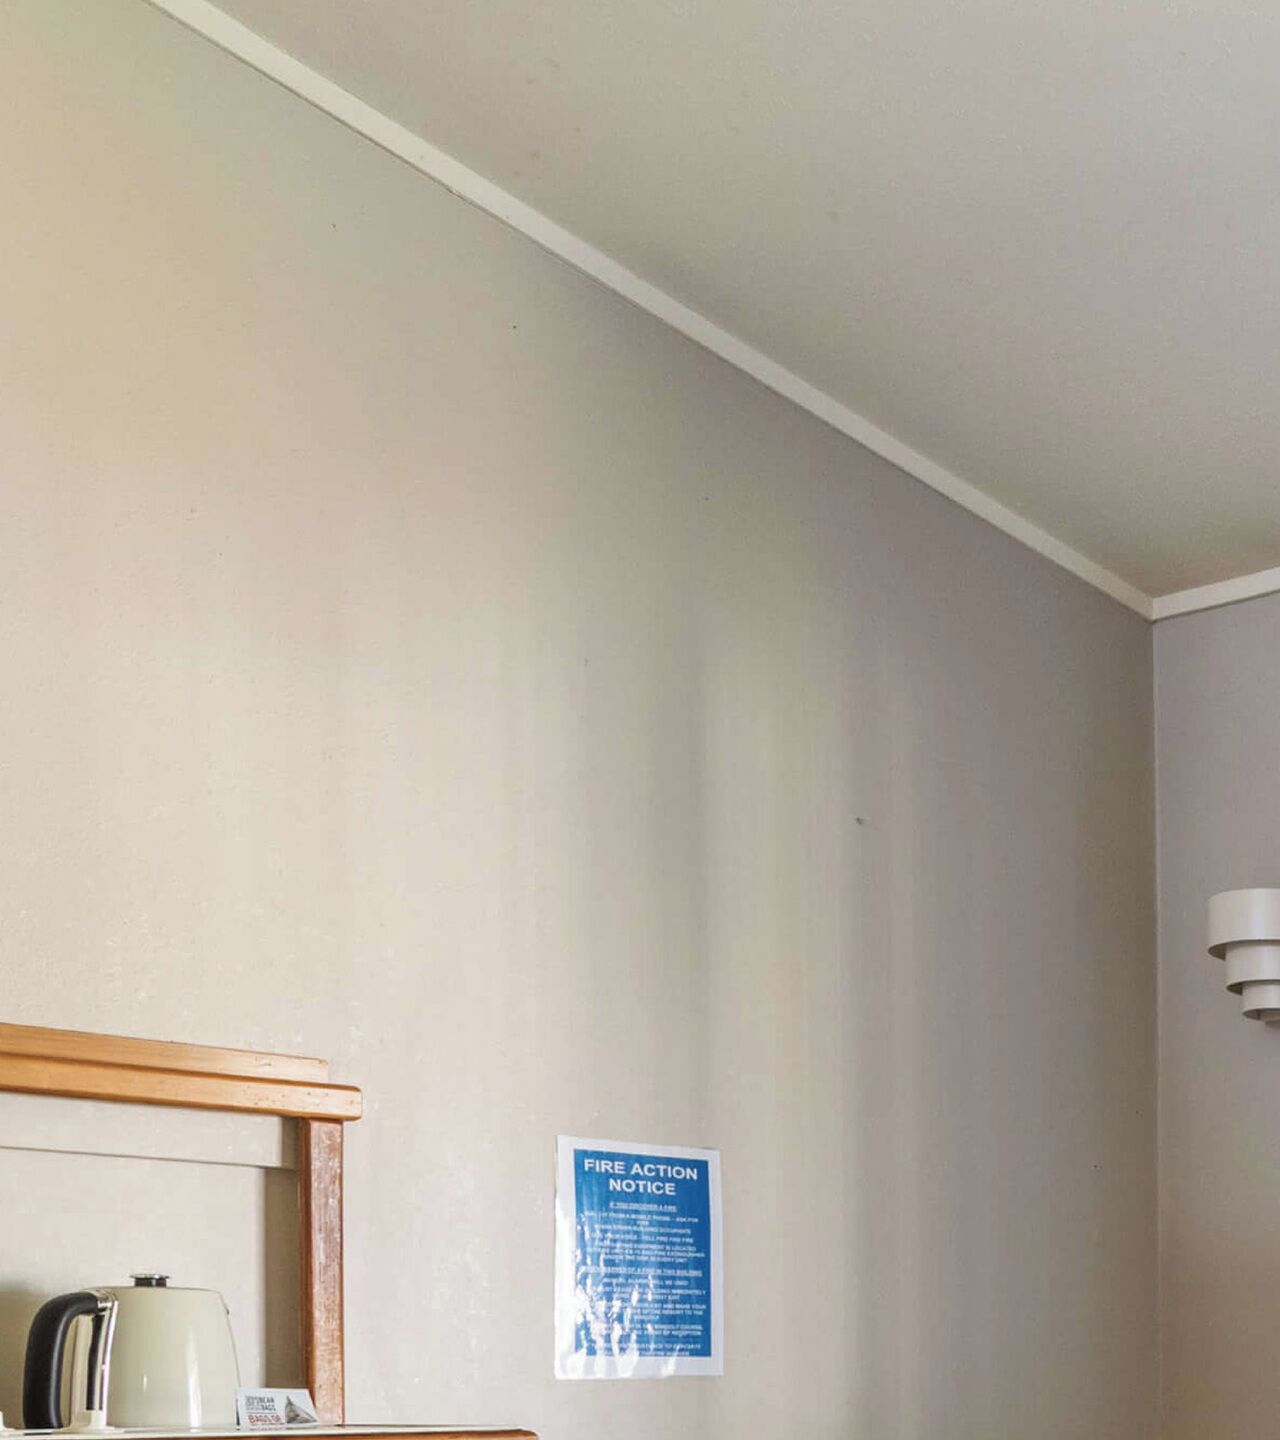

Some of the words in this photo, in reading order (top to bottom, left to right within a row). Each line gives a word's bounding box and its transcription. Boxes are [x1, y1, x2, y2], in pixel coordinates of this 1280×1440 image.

[584, 1158, 626, 1175] FIRE
[630, 1163, 698, 1180] ACTION
[608, 1178, 677, 1196] NOTICE
